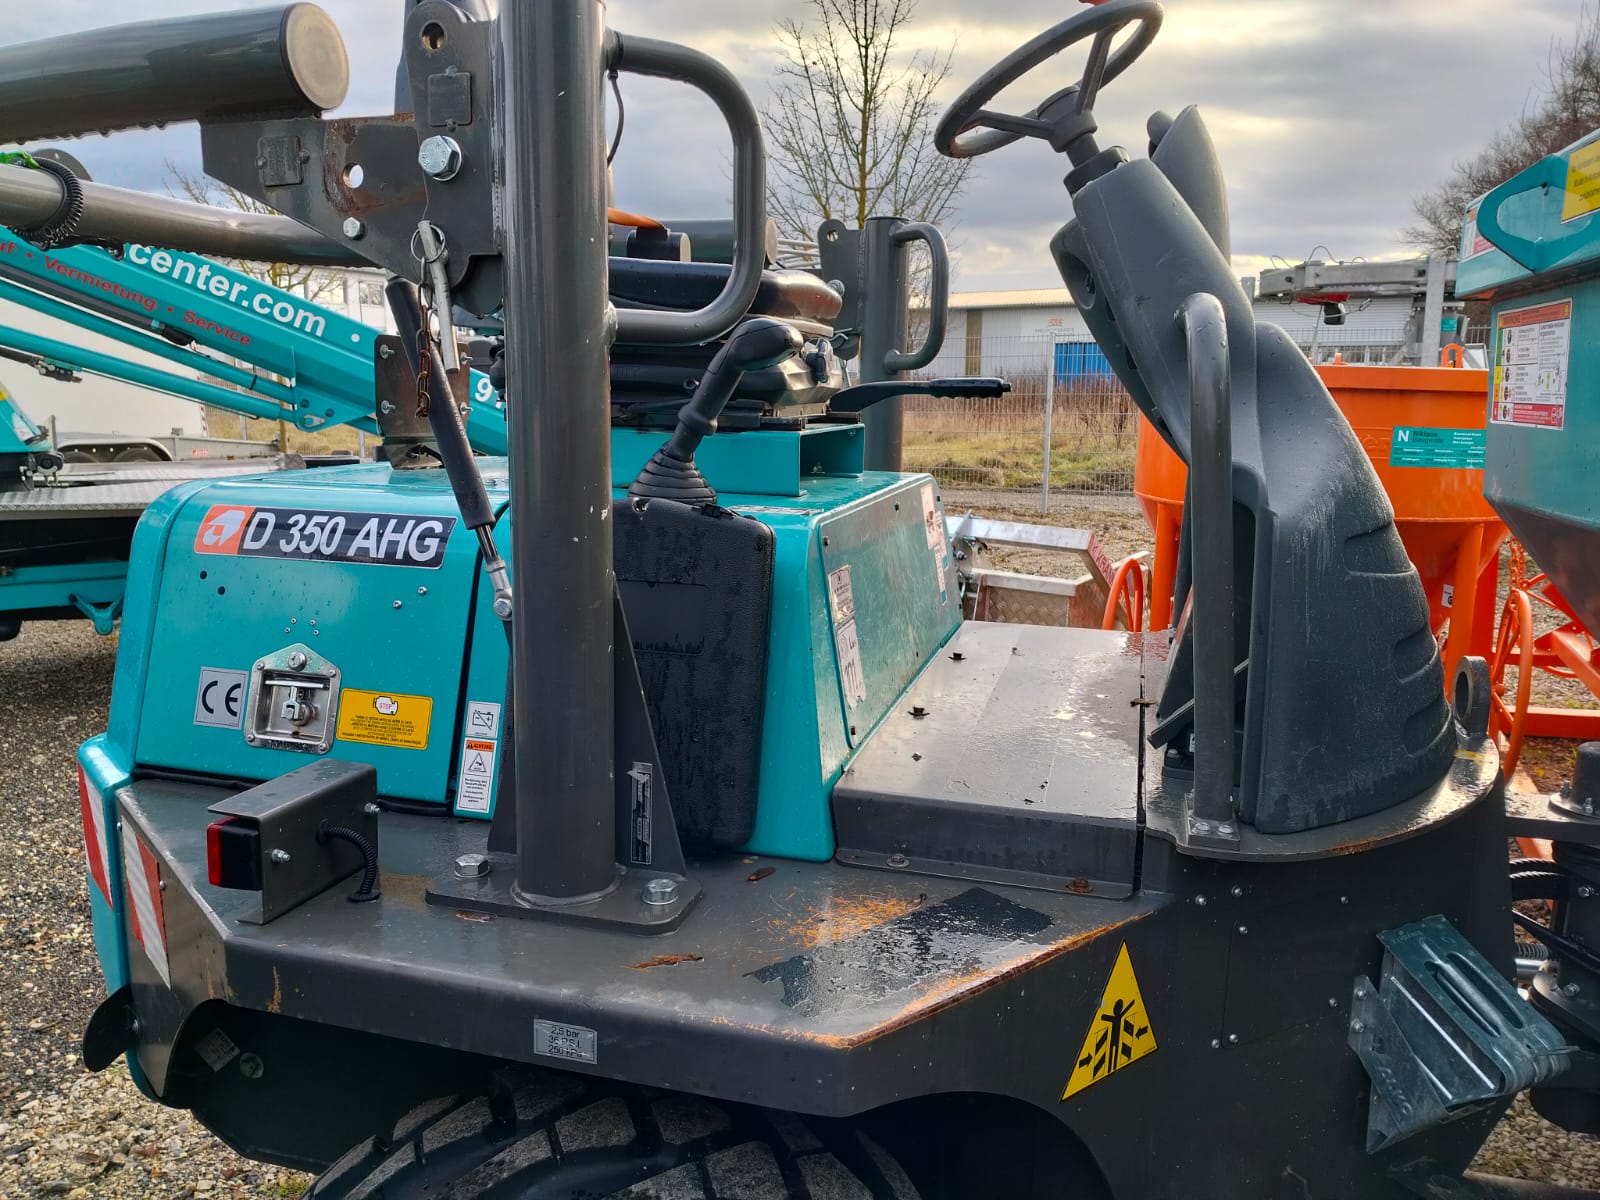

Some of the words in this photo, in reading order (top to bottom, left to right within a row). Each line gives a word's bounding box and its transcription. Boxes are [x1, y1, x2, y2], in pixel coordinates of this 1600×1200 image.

[128, 244, 327, 337] center.com
[45, 254, 158, 313] Vermietung
[183, 309, 251, 346] Service
[1397, 429, 1410, 443] N
[242, 511, 276, 551] D
[279, 513, 346, 556] 350
[346, 517, 444, 562] AHG
[201, 679, 242, 718] CE
[379, 702, 393, 710] STOP
[551, 1026, 565, 1036] 2,5
[566, 1028, 580, 1038] bar
[548, 1034, 560, 1045] 35
[548, 1044, 564, 1055] 250
